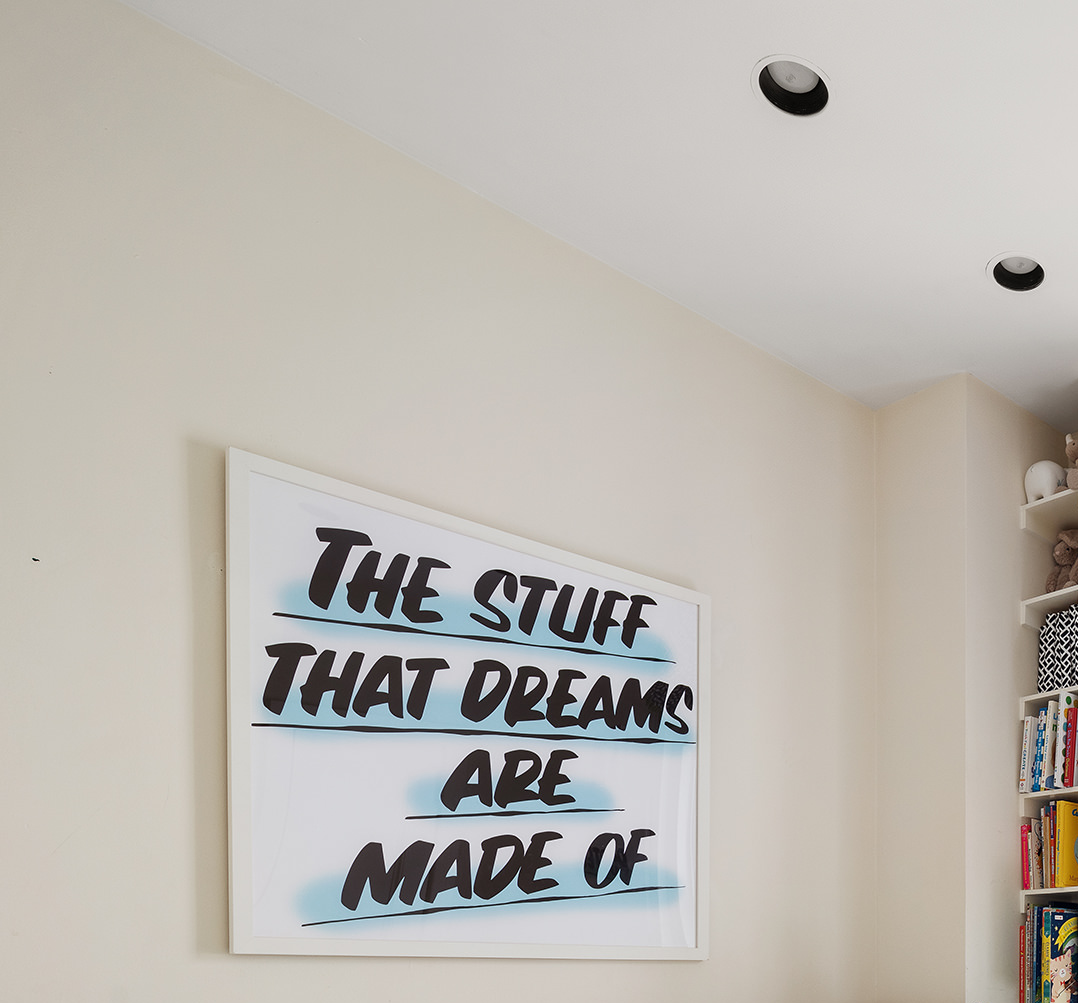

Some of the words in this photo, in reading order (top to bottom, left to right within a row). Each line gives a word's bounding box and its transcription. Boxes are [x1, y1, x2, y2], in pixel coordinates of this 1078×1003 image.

[308, 527, 451, 623] THE
[470, 569, 657, 648] STUFF
[262, 642, 450, 720] THAT
[460, 659, 693, 734] DREAMS
[440, 750, 578, 811] ARE
[341, 831, 563, 911] MADE
[583, 828, 656, 888] OF
